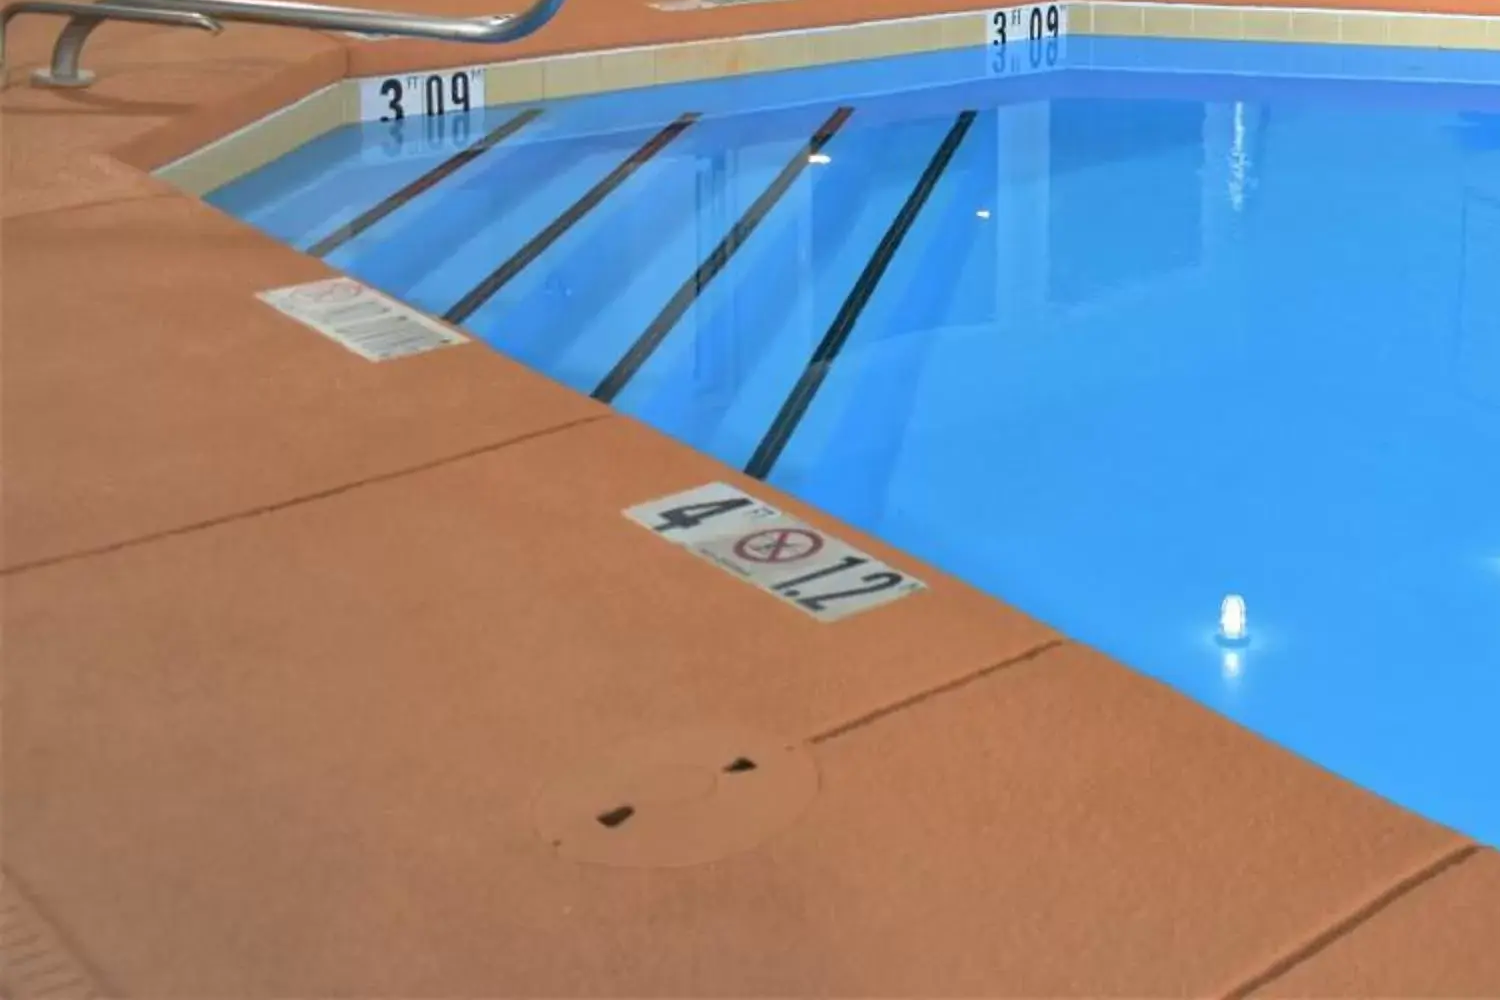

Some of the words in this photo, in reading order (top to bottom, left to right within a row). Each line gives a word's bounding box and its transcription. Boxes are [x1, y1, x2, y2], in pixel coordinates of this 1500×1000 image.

[992, 11, 1006, 46] 3
[380, 78, 404, 122] 3
[653, 498, 754, 532] 4
[771, 556, 903, 612] 1.2
